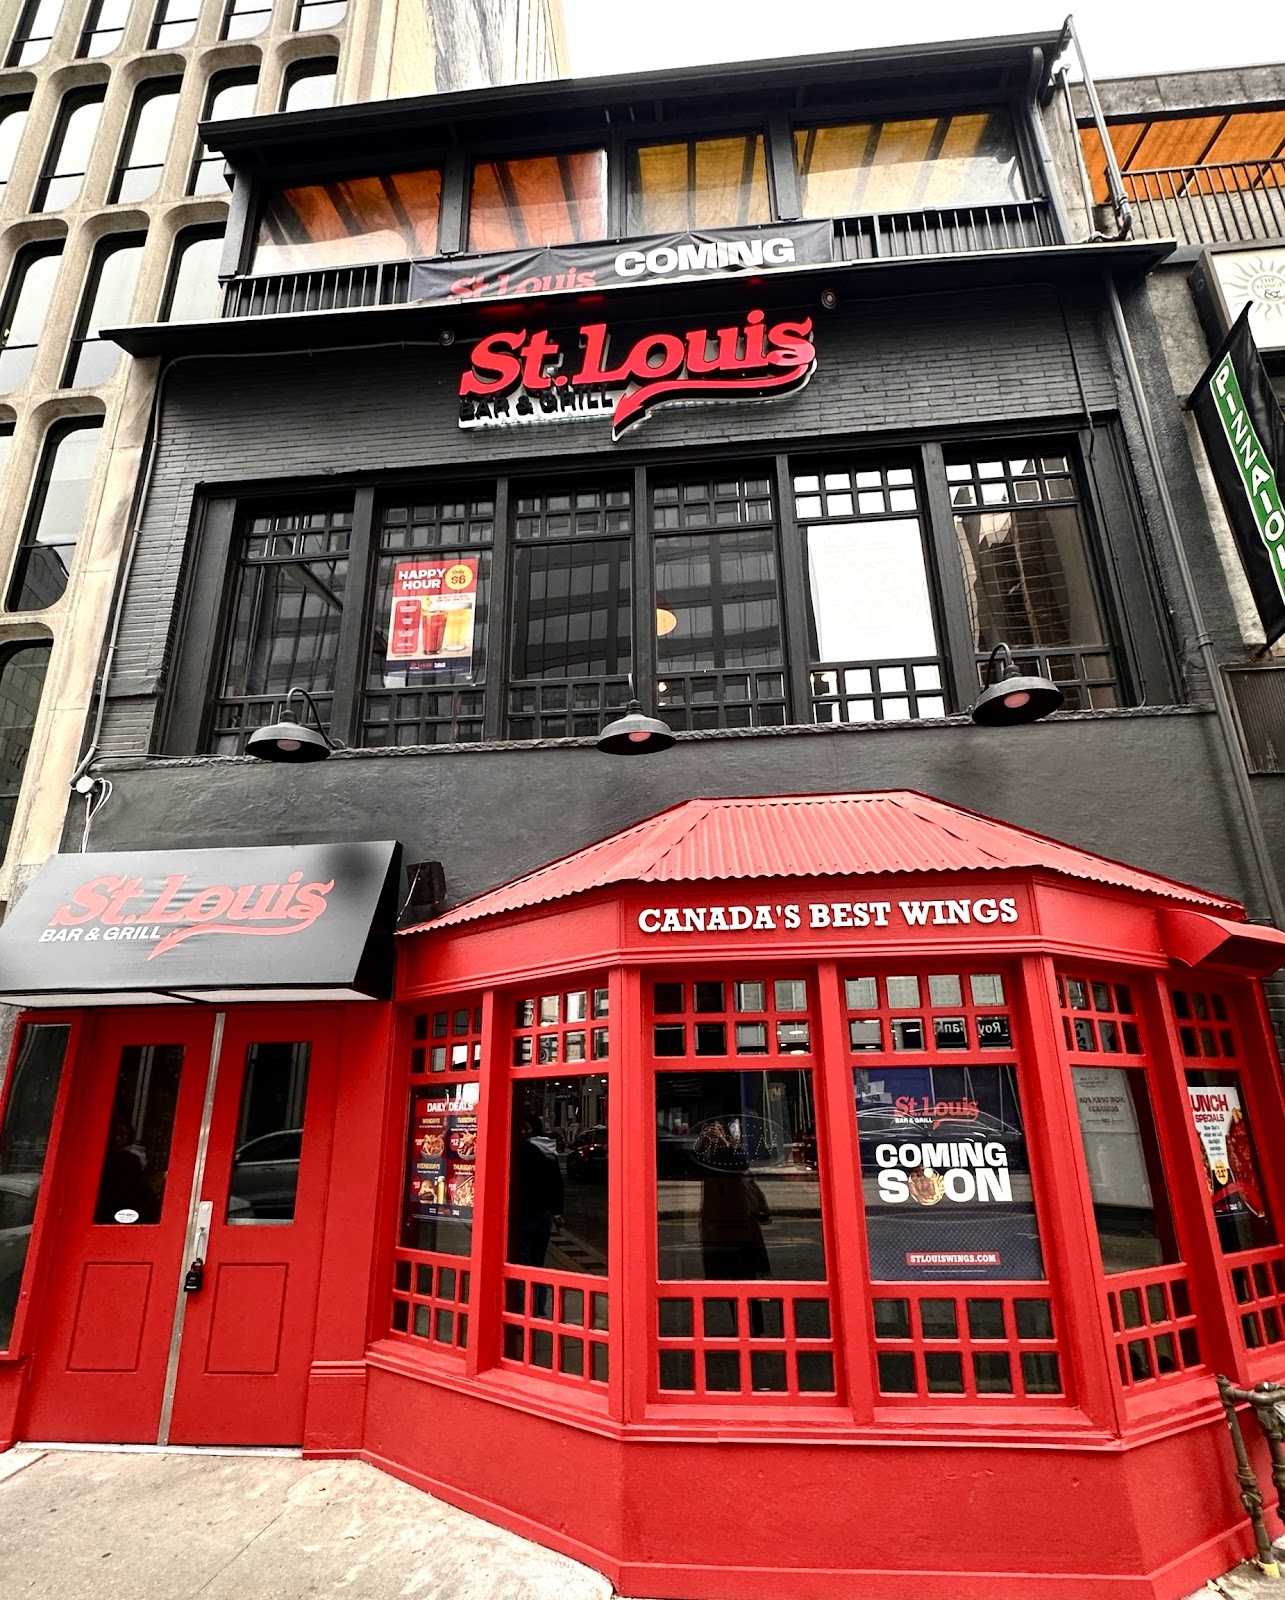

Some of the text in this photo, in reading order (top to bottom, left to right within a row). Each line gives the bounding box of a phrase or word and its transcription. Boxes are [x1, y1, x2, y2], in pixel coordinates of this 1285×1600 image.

[614, 237, 796, 277] COMING
[459, 387, 613, 421] BAR & GRILL
[398, 568, 447, 581] HAPPY
[451, 575, 466, 585] $6
[402, 579, 442, 591] HOUR
[638, 898, 1019, 933] CANADA'S BEST WINGS
[38, 925, 161, 943] BAR & GRILL
[426, 1101, 474, 1112] DAILY DEALS
[1190, 1094, 1229, 1112] UNCH
[1195, 1113, 1225, 1122] SPECIALS
[875, 1142, 1008, 1168] COMING
[877, 1167, 1013, 1203] SON
[910, 1255, 997, 1263] STLOUISWINGS.COM
